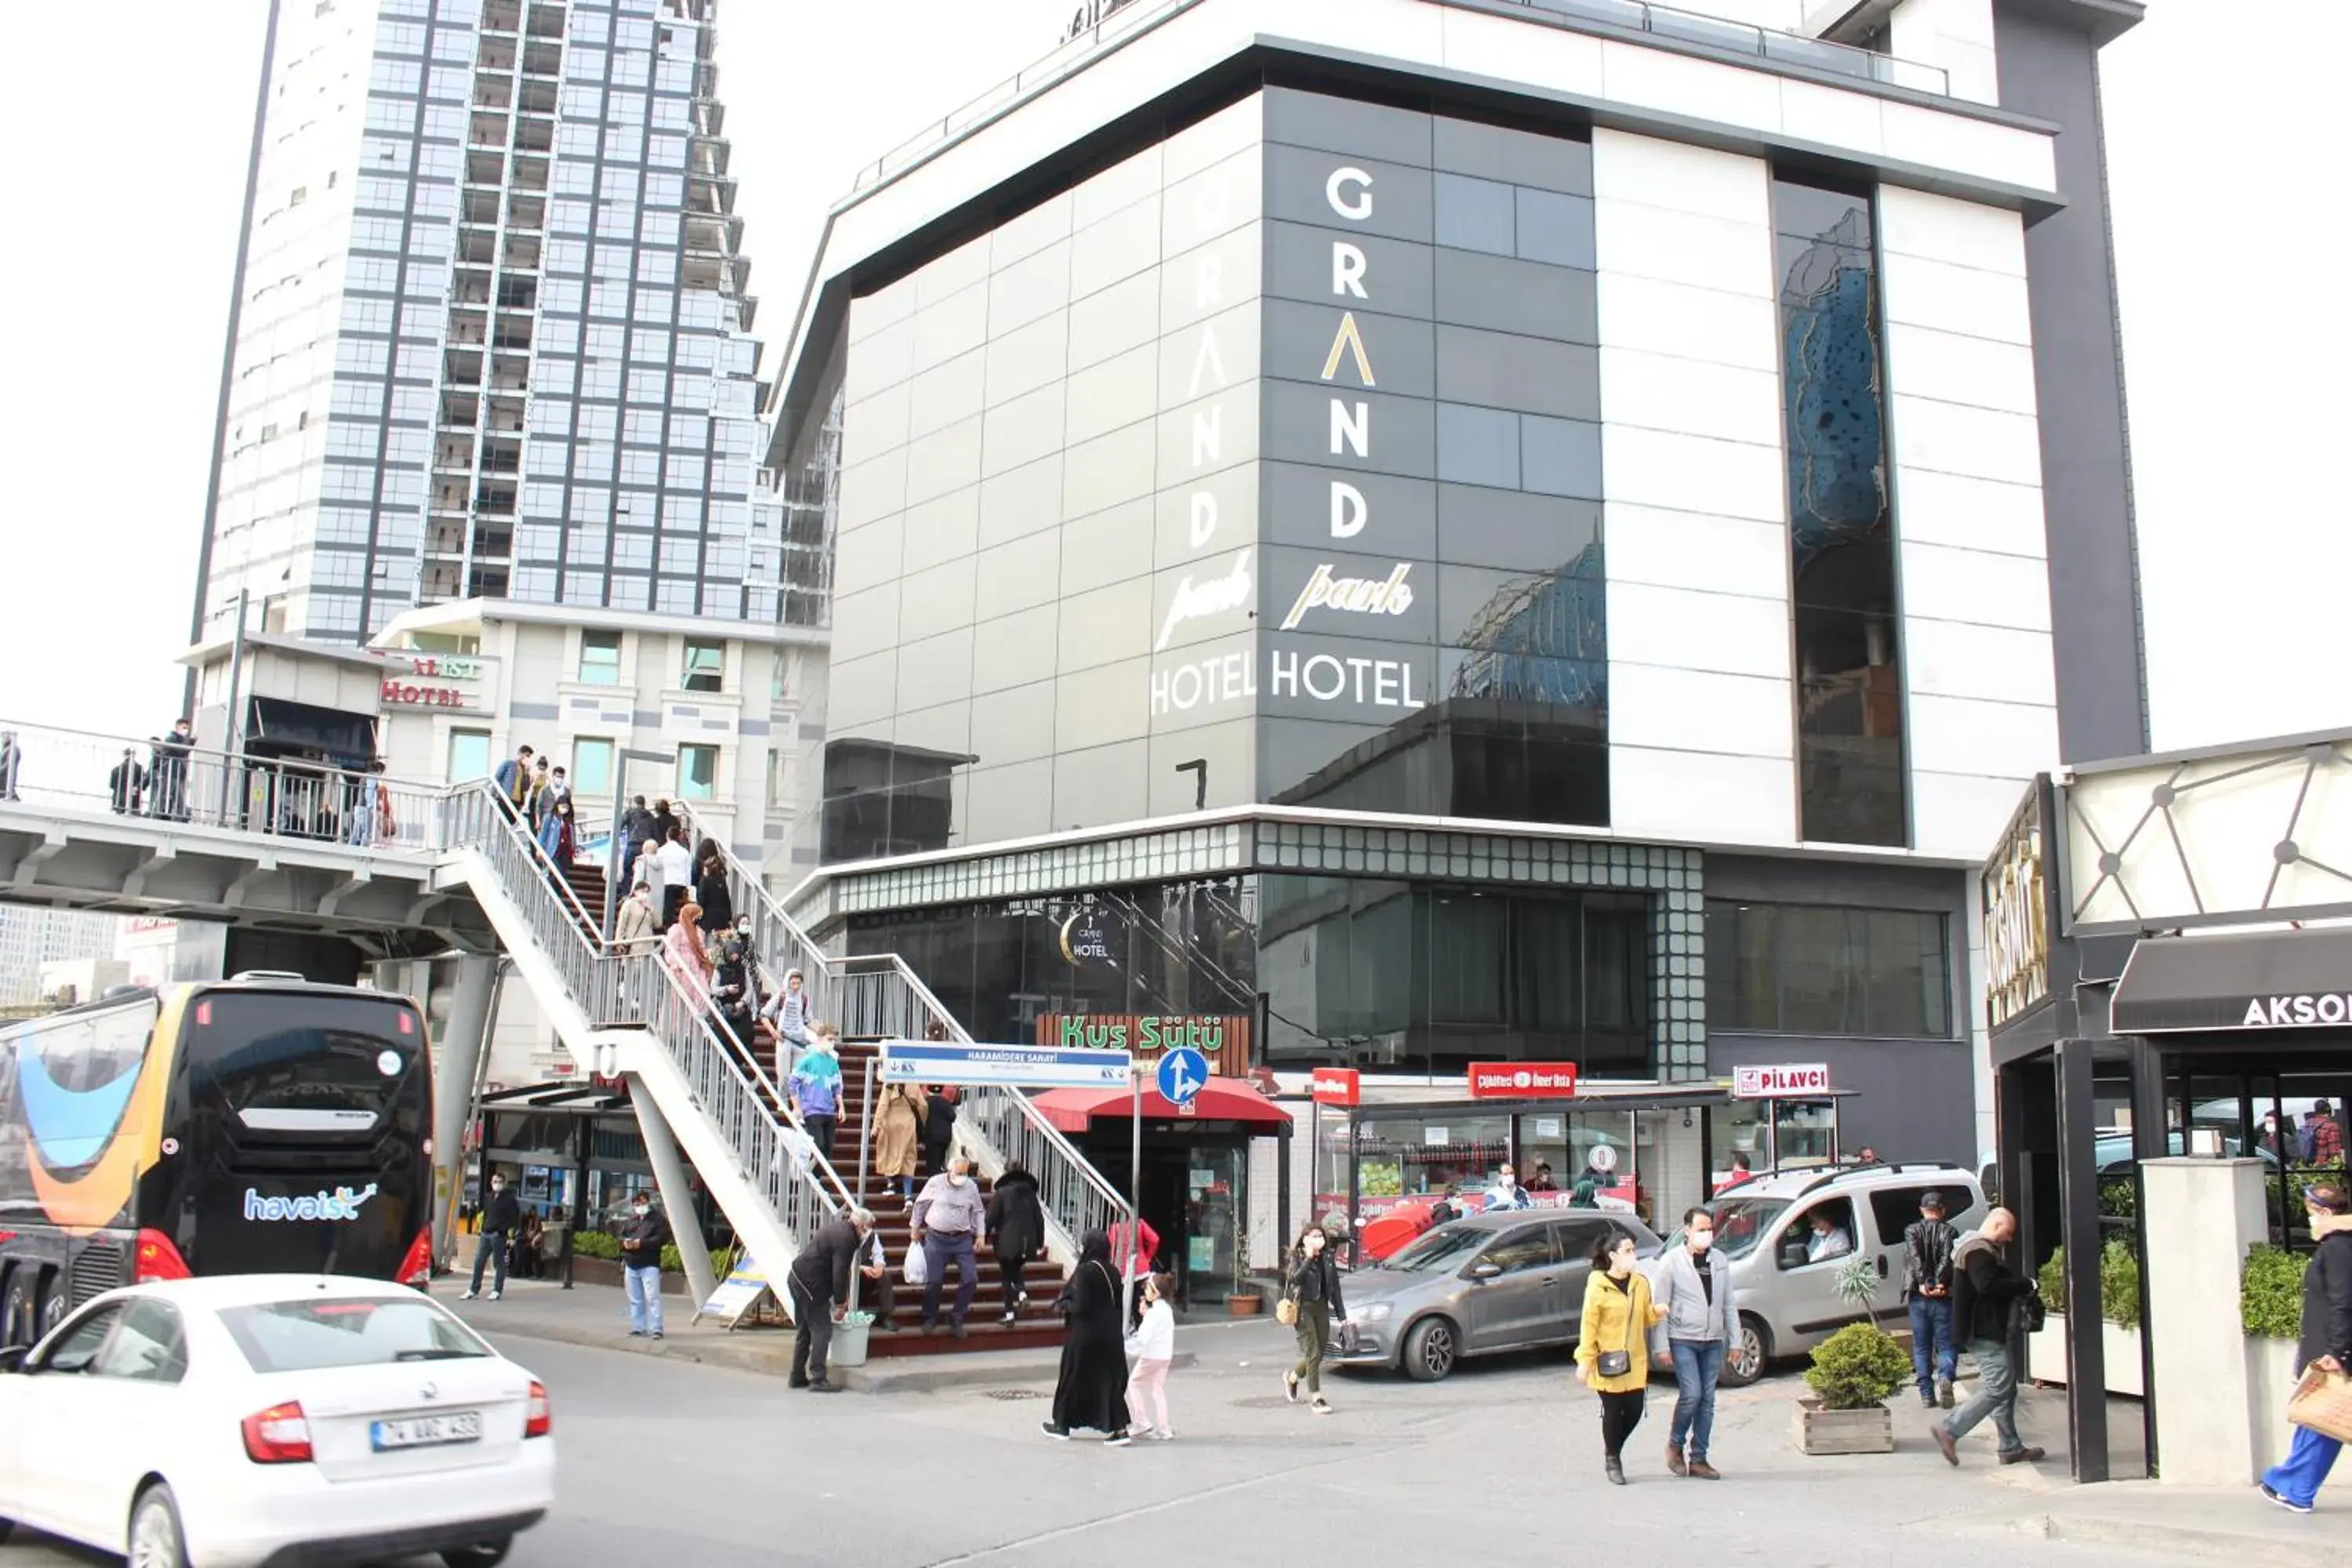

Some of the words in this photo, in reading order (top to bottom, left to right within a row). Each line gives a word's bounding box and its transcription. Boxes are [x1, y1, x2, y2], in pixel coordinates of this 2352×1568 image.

[1279, 563, 1413, 630] park
[1150, 650, 1258, 716] HOTEL
[1272, 650, 1424, 708] HOTEL
[1073, 945, 1108, 956] HOTEL
[1139, 1016, 1223, 1051] Sütü
[1761, 1069, 1825, 1089] PİLAVCI
